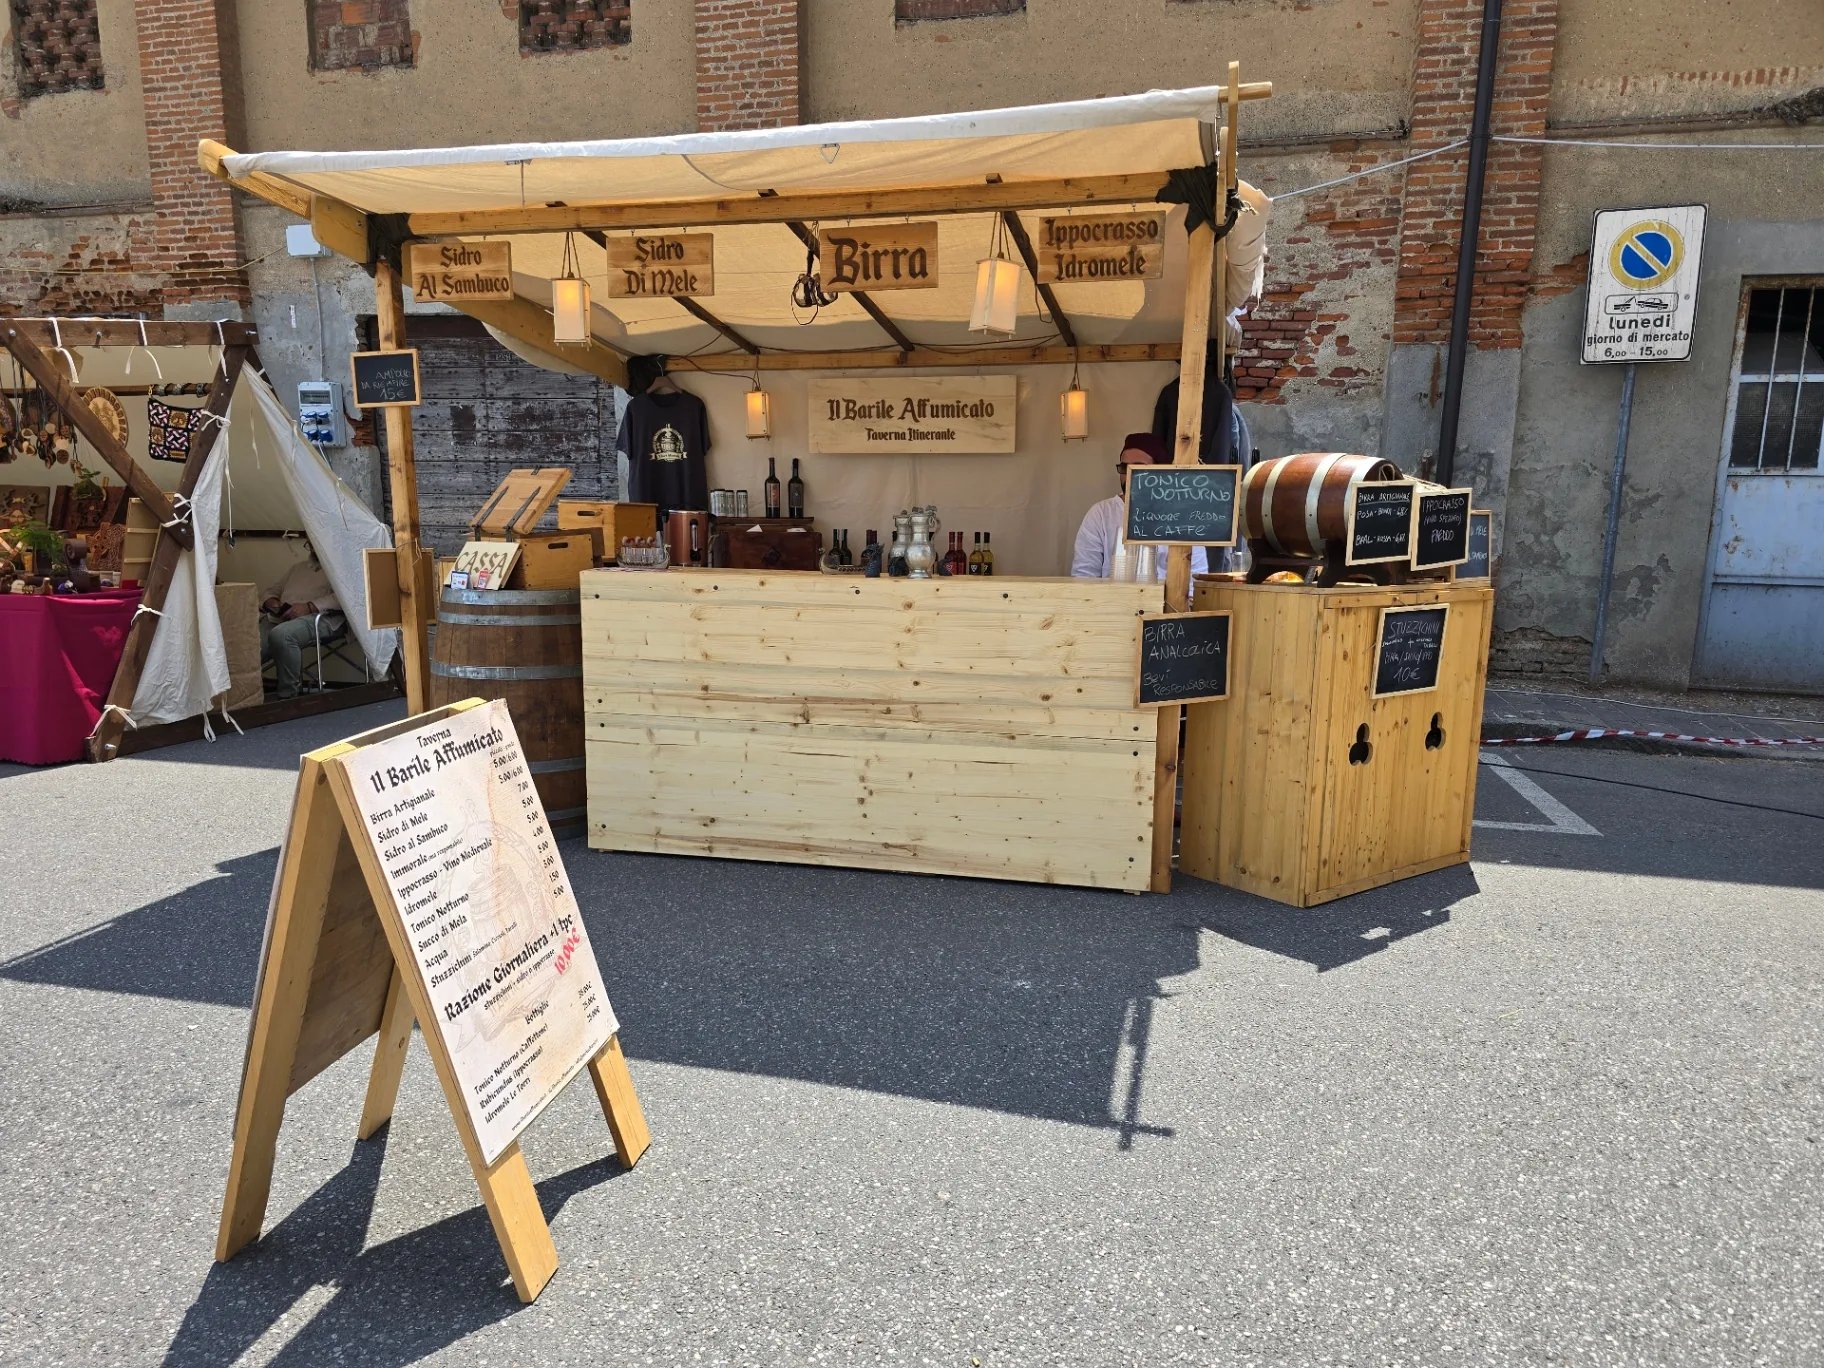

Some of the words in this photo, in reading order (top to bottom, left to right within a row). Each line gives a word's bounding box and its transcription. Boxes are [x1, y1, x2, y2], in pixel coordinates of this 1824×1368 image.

[1046, 217, 1158, 249] Ippocrasso
[440, 245, 482, 268] Sidro
[635, 237, 685, 262] Sidro
[827, 233, 929, 286] Birra
[1055, 245, 1147, 281] Idromele
[416, 274, 437, 298] Al
[442, 271, 510, 296] Sambuco
[622, 265, 646, 295] Di
[651, 268, 698, 295] Mele
[1587, 333, 1623, 347] giorno
[1627, 332, 1638, 343] di
[1642, 330, 1690, 342] mercato
[379, 387, 408, 400] 15€
[826, 399, 841, 421] Il
[841, 397, 895, 422] Barile
[897, 397, 995, 423] Affumicato
[865, 427, 906, 442] Taverna
[907, 427, 956, 442] Itinerante
[1150, 487, 1231, 504] NOTTURNO
[455, 550, 508, 579] CASSA
[1144, 622, 1186, 643] BIRRA
[1393, 666, 1421, 683] 10€
[416, 728, 452, 748] Taverna
[370, 770, 385, 793] Il
[386, 754, 431, 788] Barile
[433, 726, 503, 771] Affumicato
[369, 809, 393, 825] Birra
[393, 788, 435, 815] Artigianale
[377, 826, 399, 843] Sidro
[401, 820, 410, 832] di
[409, 812, 428, 827] Mele
[384, 844, 406, 862] Sidro
[407, 837, 416, 850] al
[416, 823, 448, 845] Sambuco
[390, 853, 428, 879] Immorale
[397, 869, 438, 900] Ippocrasso
[442, 857, 460, 871] Vino
[459, 837, 492, 862] Medievale
[404, 890, 437, 915] Idromele
[410, 913, 436, 933] Tonico
[435, 893, 469, 918] Notturno
[418, 932, 440, 952] Succo
[441, 925, 449, 937] di
[448, 914, 467, 931] Mela
[424, 949, 448, 968] Acqua
[430, 954, 472, 988] Stuzzichini
[444, 978, 492, 1021] Razione
[493, 934, 549, 984] Giornaliera
[524, 1000, 549, 1025] Bottiglie
[473, 1074, 494, 1094] Tonico
[493, 1051, 519, 1077] Notturno
[509, 1090, 517, 1100] Le
